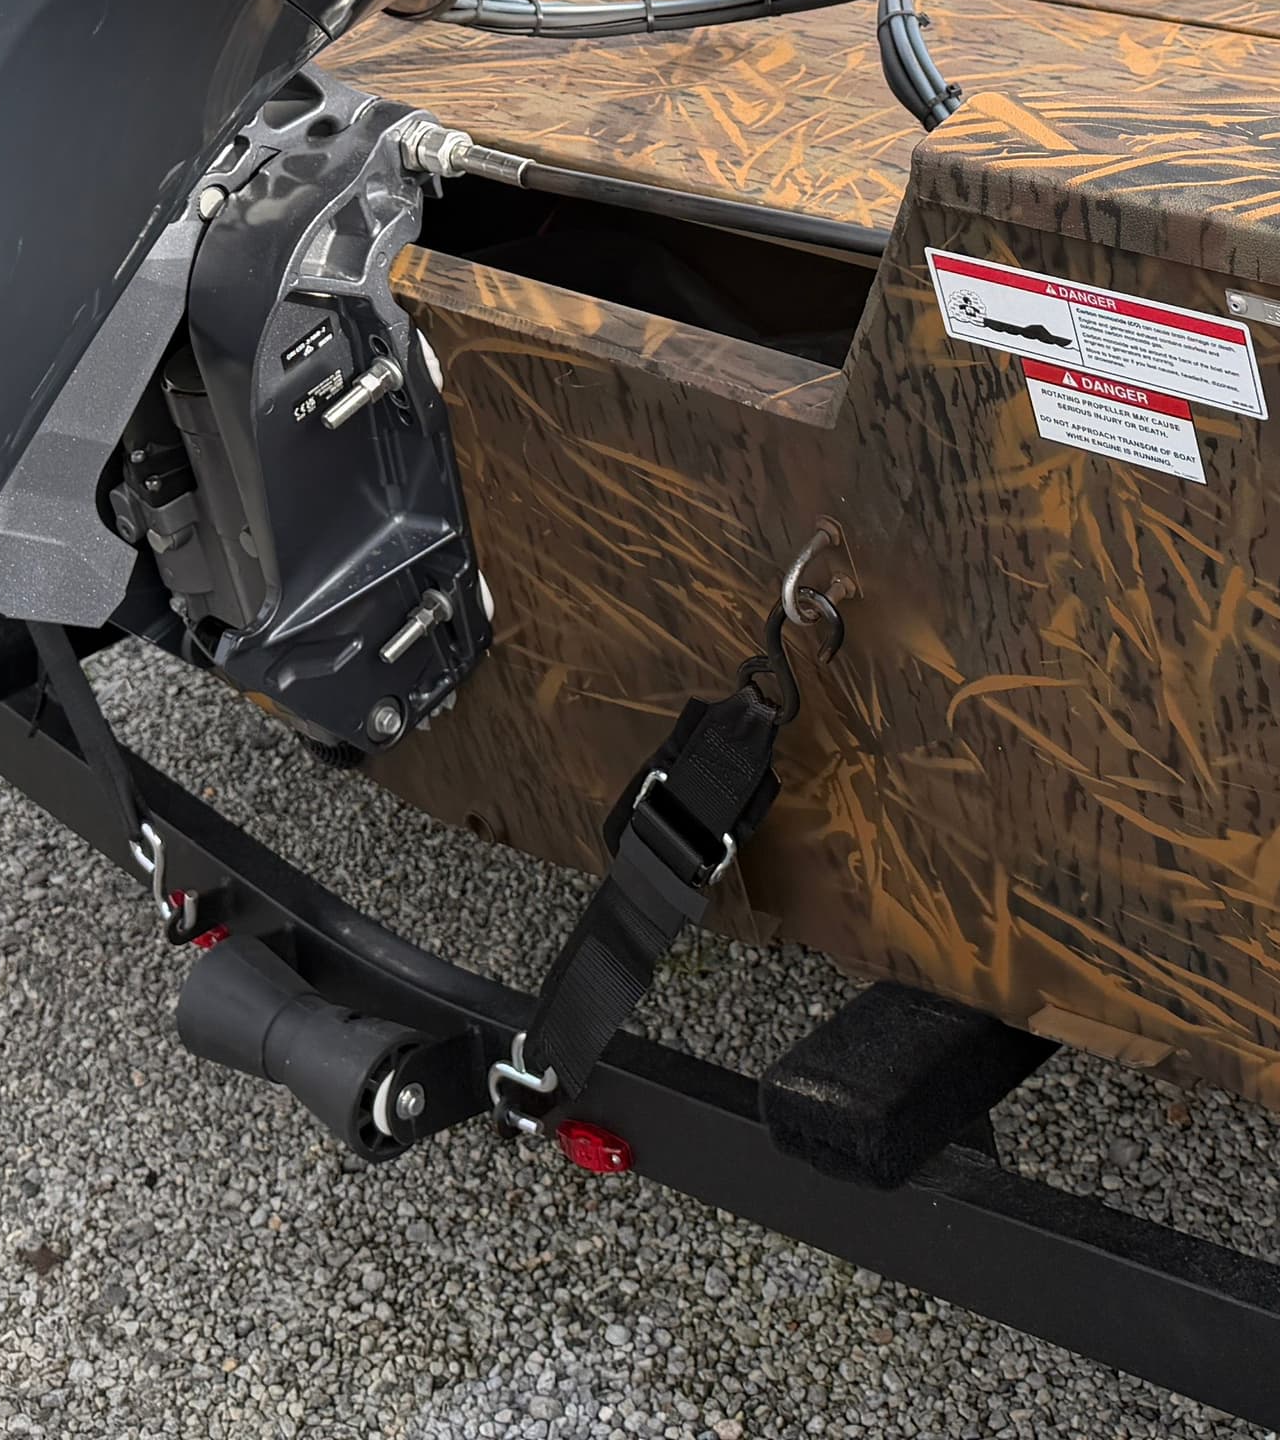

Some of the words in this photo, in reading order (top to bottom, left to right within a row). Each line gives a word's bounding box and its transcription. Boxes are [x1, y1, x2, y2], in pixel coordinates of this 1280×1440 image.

[1058, 286, 1116, 310] DANGER
[1080, 376, 1148, 405] DANGER
[1041, 387, 1080, 404] ROTATING
[1081, 398, 1130, 418] PROPELLER
[1132, 412, 1149, 423] MAY
[1151, 418, 1180, 432] CAUSE
[1057, 402, 1091, 416] SERIOUS
[1093, 412, 1121, 425] INJURY
[1124, 421, 1136, 429] OR
[1039, 414, 1051, 422] DO
[1053, 418, 1069, 427] NOT
[1070, 423, 1115, 440] APPROACH
[1118, 436, 1157, 452] TRANSOM
[1159, 448, 1171, 456] OF
[1173, 451, 1195, 463] BOAT
[1066, 431, 1089, 443] WHEN
[1091, 438, 1120, 452] ENGINE
[1123, 447, 1131, 455] IS
